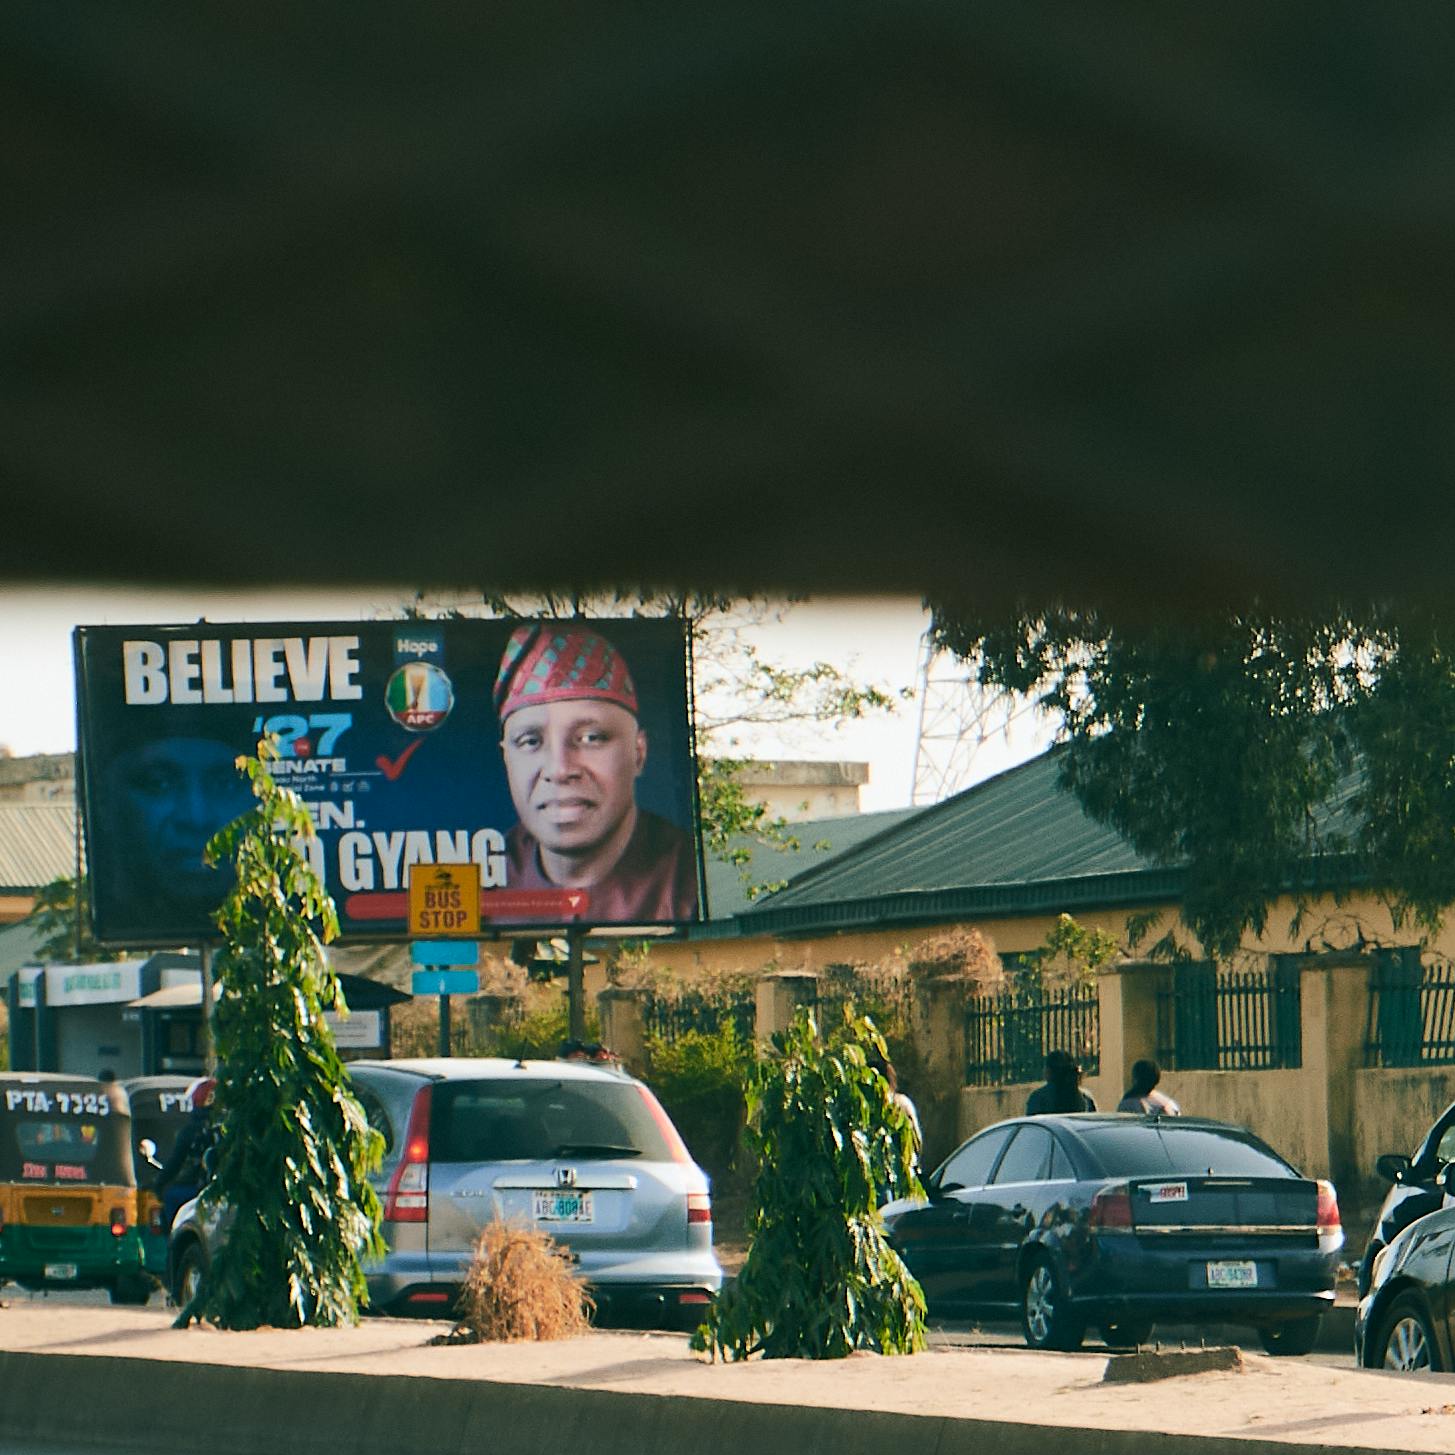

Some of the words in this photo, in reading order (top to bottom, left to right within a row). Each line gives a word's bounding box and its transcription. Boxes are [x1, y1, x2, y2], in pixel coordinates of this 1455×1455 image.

[397, 639, 438, 657] Hope
[123, 635, 363, 704] BELIEVE
[408, 714, 434, 724] APC
[339, 828, 507, 891] GYANG
[425, 890, 461, 909] BUS
[419, 911, 468, 929] STOP
